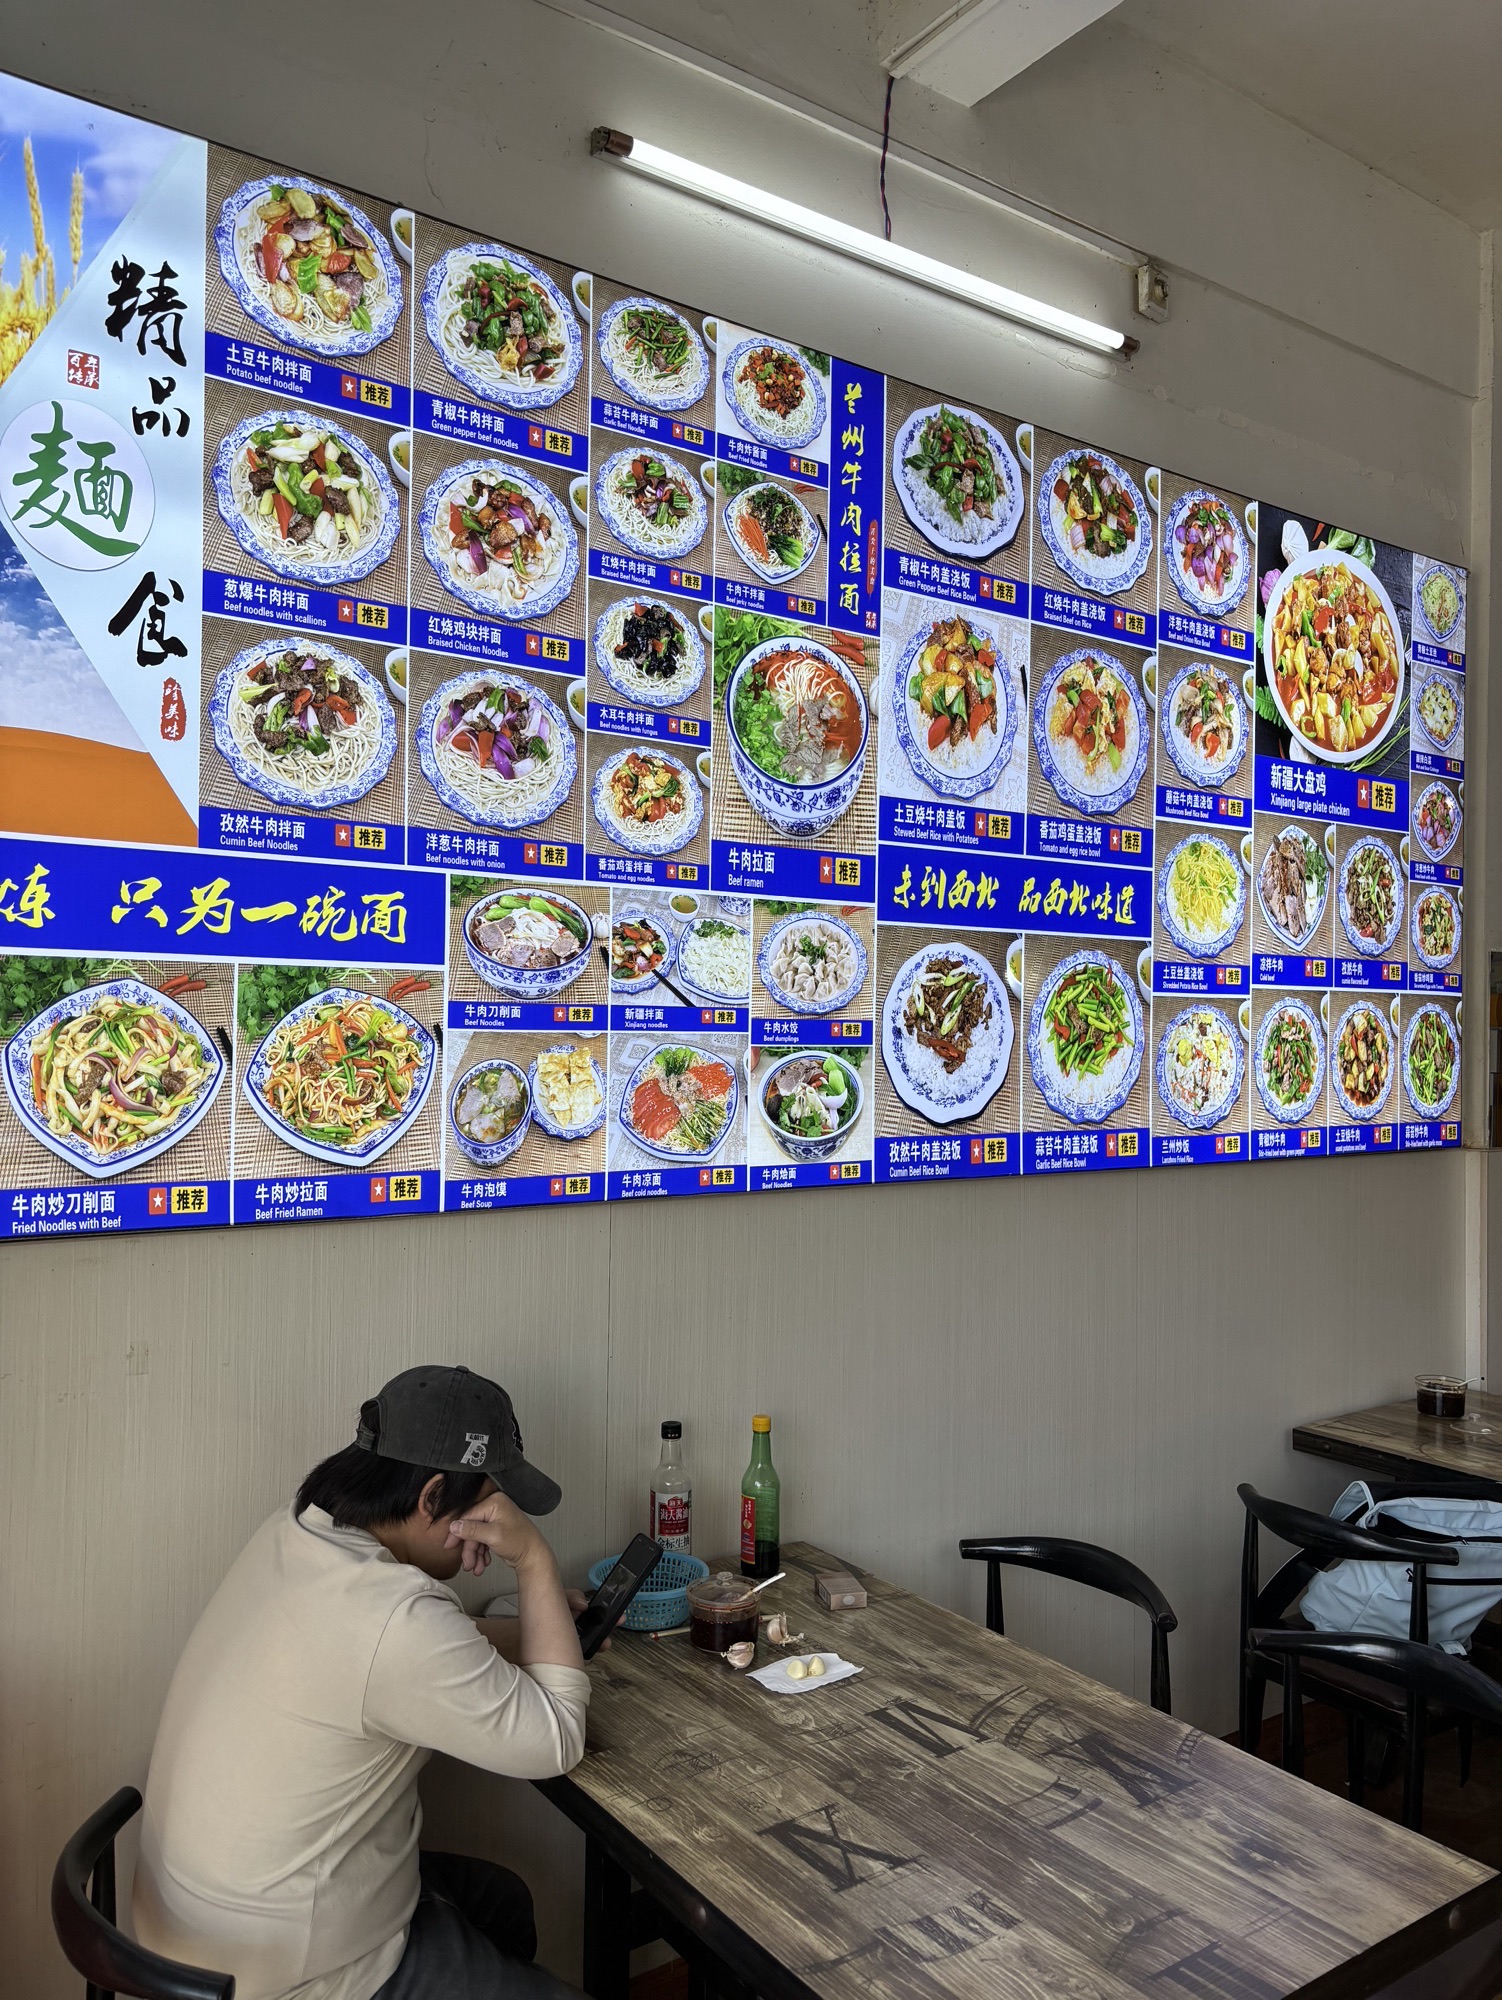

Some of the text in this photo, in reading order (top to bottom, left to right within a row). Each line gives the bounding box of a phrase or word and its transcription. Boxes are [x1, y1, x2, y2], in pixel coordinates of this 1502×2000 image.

[226, 343, 312, 383] 土豆牛肉拌面
[227, 364, 303, 393] Potato beef noodles
[365, 383, 389, 405] 推荐
[432, 399, 505, 434] 青椒牛肉拌面
[604, 403, 658, 430] 蒜苔牛肉拌面
[432, 419, 519, 449] Green pepper beef noodles
[549, 433, 570, 453] 推荐
[686, 428, 703, 443] 推荐
[728, 439, 767, 460] 牛肉炸酱面
[728, 452, 767, 468] Beef Fried Noodles
[803, 462, 818, 476] 推荐
[602, 554, 656, 578] 红烧牛肉拌面
[899, 556, 970, 589] 青椒牛肉盖浇饭
[601, 568, 650, 585] Braised Beef Noodles
[684, 575, 700, 589] 推荐
[224, 578, 309, 611] 葱爆牛肉拌面
[726, 583, 765, 602] 牛肉干拌面
[899, 576, 976, 602] Green Pepper Beef Rice Bowl
[996, 582, 1014, 601] 推荐
[224, 601, 327, 627] Beef noodles with scallions
[362, 605, 386, 626] 推荐
[800, 599, 815, 614] 推荐
[1045, 592, 1106, 622] 红烧牛肉盖浇饭
[428, 615, 502, 645] 红烧鸡块拌面
[1129, 615, 1143, 633] 推荐
[428, 636, 509, 658] Braised Chicken Noodles
[546, 639, 567, 658] 推荐
[1233, 633, 1244, 648] 推荐
[600, 707, 655, 727] 木耳牛肉拌面
[683, 721, 698, 735] 推荐
[1271, 763, 1326, 797] 新疆大盘鸡
[1270, 792, 1350, 816] Xinjiang large plate chicken
[1375, 785, 1393, 810] 推荐
[894, 803, 965, 830] 土豆烧牛肉盖饭
[992, 816, 1009, 836] 推荐
[220, 813, 305, 840] 孜然牛肉拌面
[894, 826, 979, 845] Stewed Beef Rice with Potatoes
[1040, 820, 1101, 845] 番茄鸡蛋盖浇饭
[220, 835, 298, 851] Cumin Beef Noodles
[359, 829, 383, 847] 推荐
[426, 833, 500, 858] 洋葱牛肉拌面
[1125, 832, 1139, 851] 推荐
[426, 853, 505, 869] Beef noodles with onion
[544, 847, 565, 865] 推荐
[728, 847, 775, 874] 牛肉拉面
[599, 858, 653, 874] 番茄鸡蛋拌面
[681, 867, 696, 879] 推荐
[839, 860, 858, 883] 推荐
[728, 874, 764, 888] Beef ramen
[1163, 965, 1204, 980] 土豆丝盖浇饭
[1228, 969, 1240, 983] 推荐
[465, 1004, 521, 1019] 牛肉刀削面
[572, 1008, 591, 1021] 推荐
[625, 1008, 664, 1020] 新疆拌面
[718, 1011, 734, 1022] 推荐
[480, 1019, 505, 1027] Noodles
[764, 1021, 798, 1034] 牛肉水饺
[845, 1024, 860, 1035] 推荐
[889, 1140, 961, 1163] 孜然牛肉盖浇饭
[988, 1140, 1004, 1160] 推荐
[1036, 1134, 1098, 1156] 蒜苔牛肉盖浇饭
[1121, 1135, 1136, 1154] 推荐
[1162, 1139, 1189, 1154] 兰州炒饭
[1227, 1138, 1239, 1151] 推荐
[622, 1172, 662, 1188] 牛肉凉面
[716, 1170, 732, 1184] 推荐
[762, 1168, 797, 1181] 牛肉烩面
[844, 1165, 859, 1177] 推荐
[889, 1164, 949, 1177] Cumin Beef Rice Bowl
[255, 1181, 328, 1206] 牛肉炒拉面
[394, 1178, 419, 1199] 推荐
[461, 1182, 507, 1198] 牛肉泡馍
[569, 1178, 589, 1193] 推荐
[12, 1190, 116, 1218] 牛肉炒刀削面
[177, 1189, 205, 1211] 推荐
[461, 1200, 492, 1209] Beef Soup
[255, 1206, 323, 1220] Beef Fried Ramen
[12, 1216, 122, 1234] Fried Noodles with Beef
